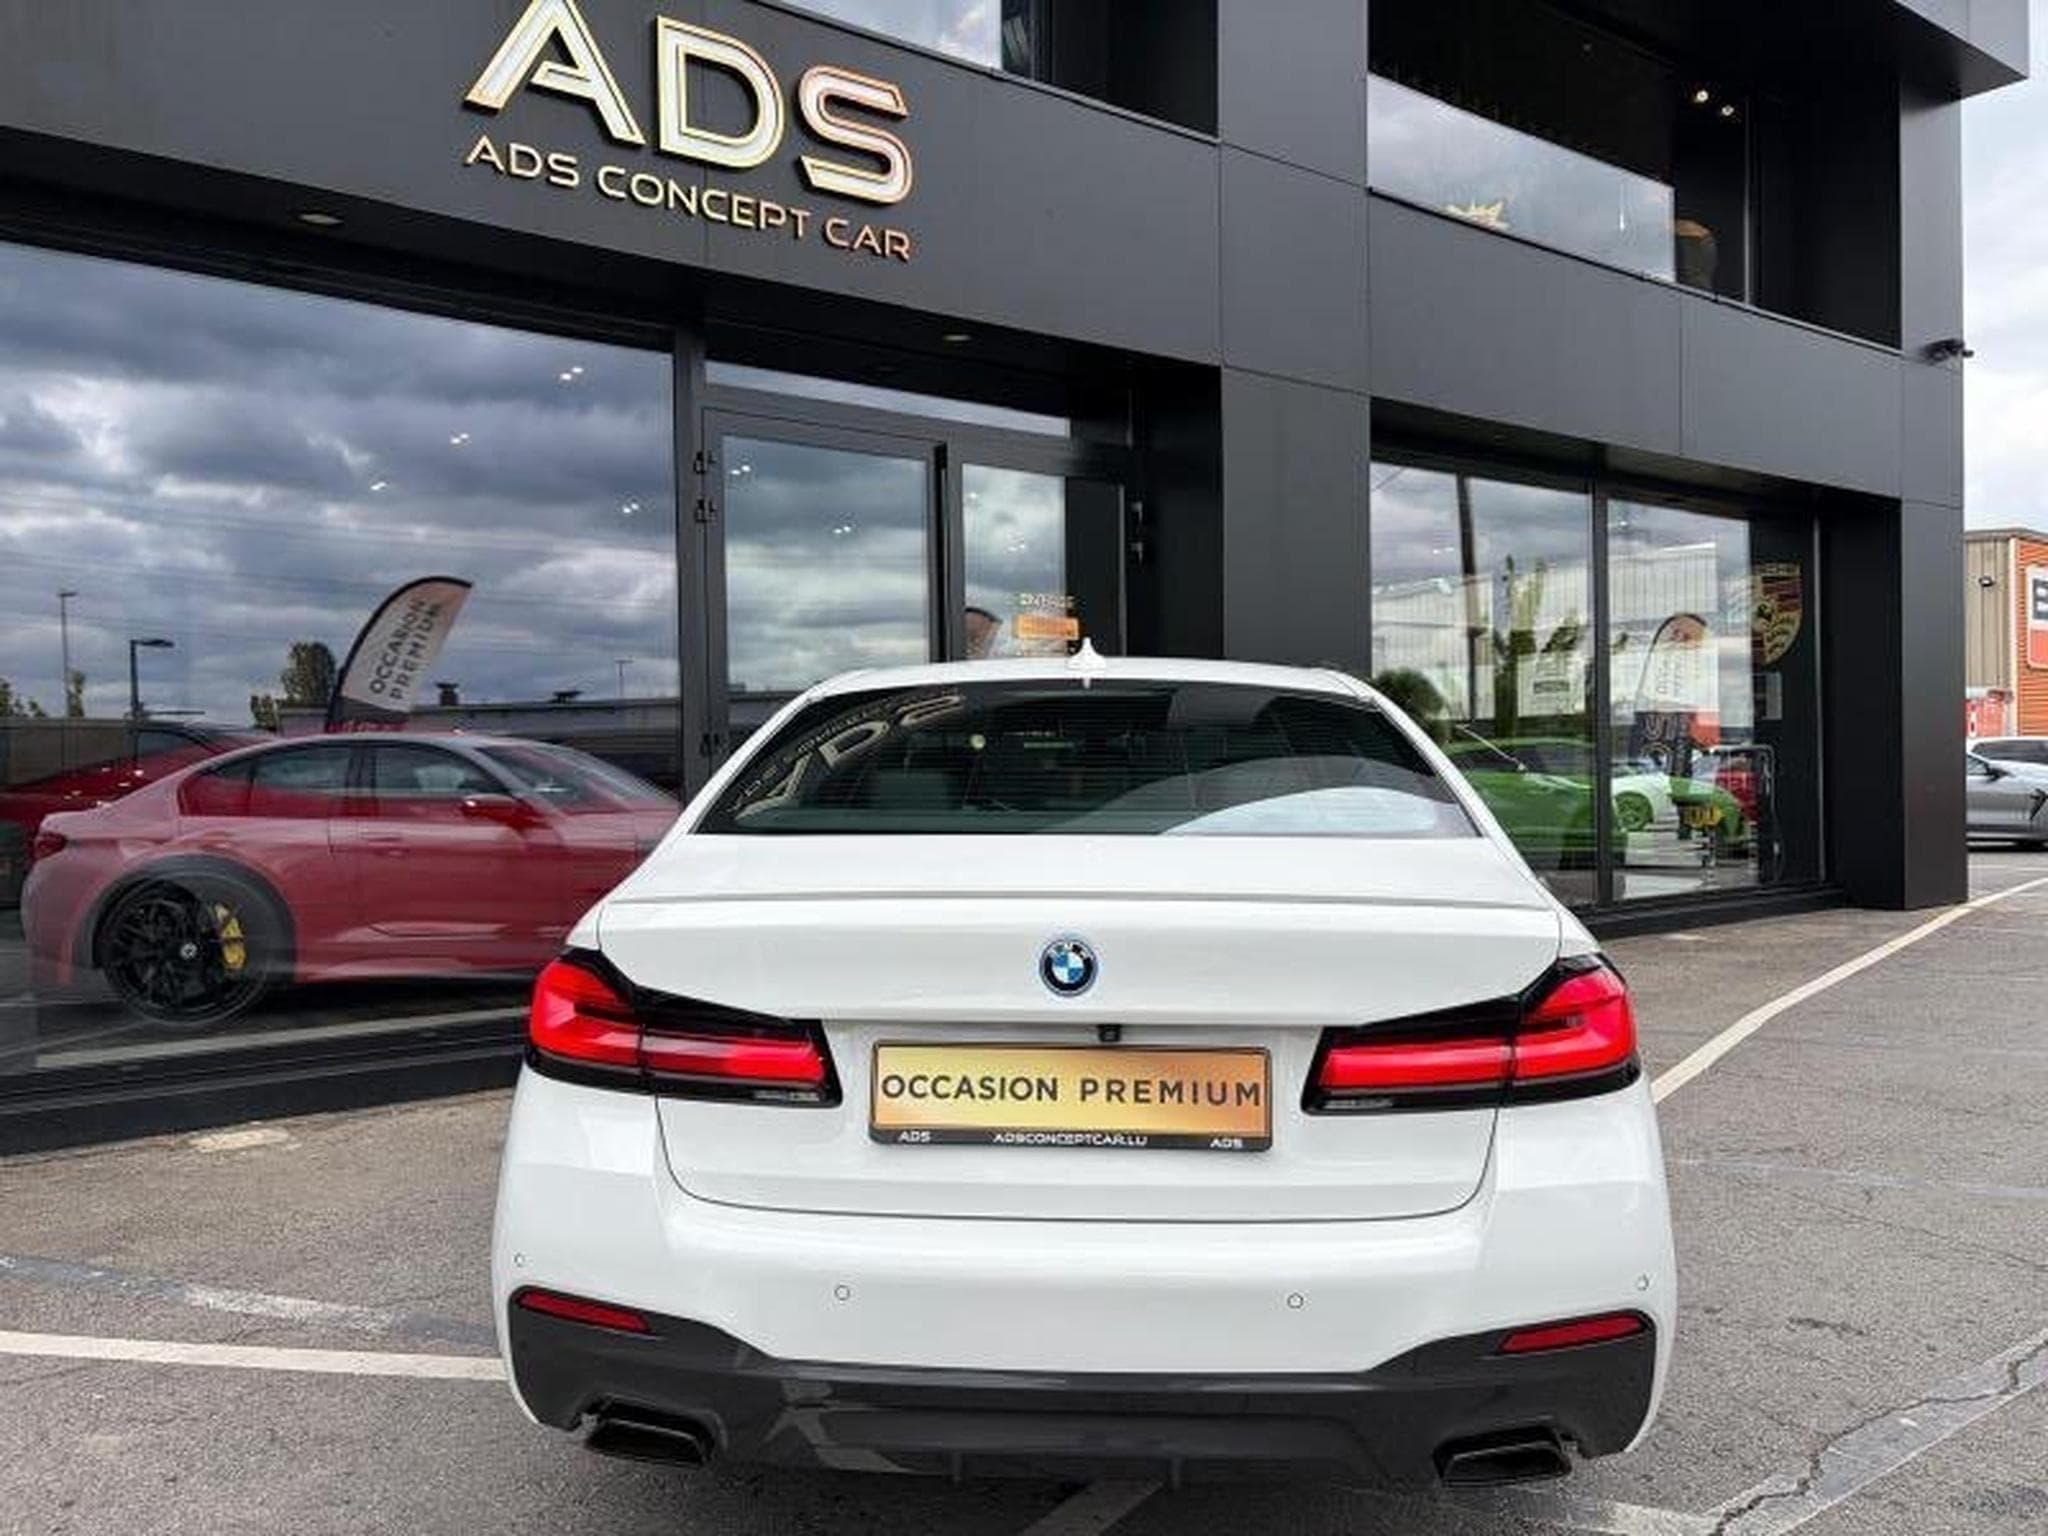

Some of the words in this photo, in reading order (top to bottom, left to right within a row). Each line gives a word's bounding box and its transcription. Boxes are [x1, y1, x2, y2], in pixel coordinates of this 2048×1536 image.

[463, 0, 914, 204] ADS
[464, 135, 580, 188] ADS
[598, 165, 811, 239] CONCEPT
[825, 218, 911, 261] CAR
[369, 600, 426, 694] OCCASION
[882, 1074, 1058, 1101] OCCASION
[1080, 1078, 1261, 1107] PREMIUM
[898, 1130, 932, 1143] ADS
[1210, 1137, 1243, 1148] ADS
